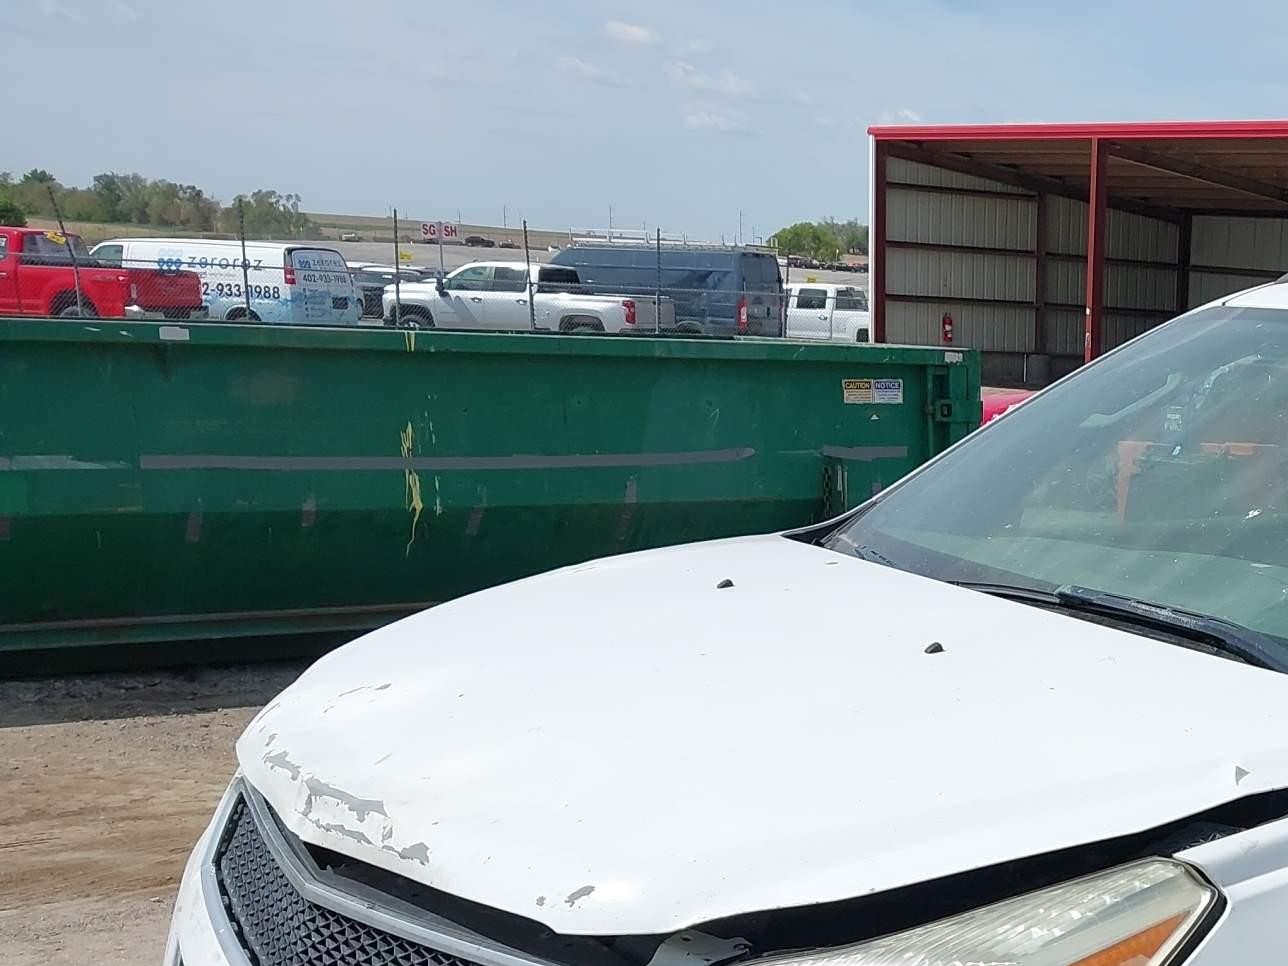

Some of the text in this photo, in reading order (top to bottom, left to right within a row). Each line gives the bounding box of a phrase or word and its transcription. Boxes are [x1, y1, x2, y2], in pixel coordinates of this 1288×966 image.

[422, 223, 458, 237] SG SH
[187, 256, 264, 271] zerorez
[201, 282, 281, 300] 2-933-1988
